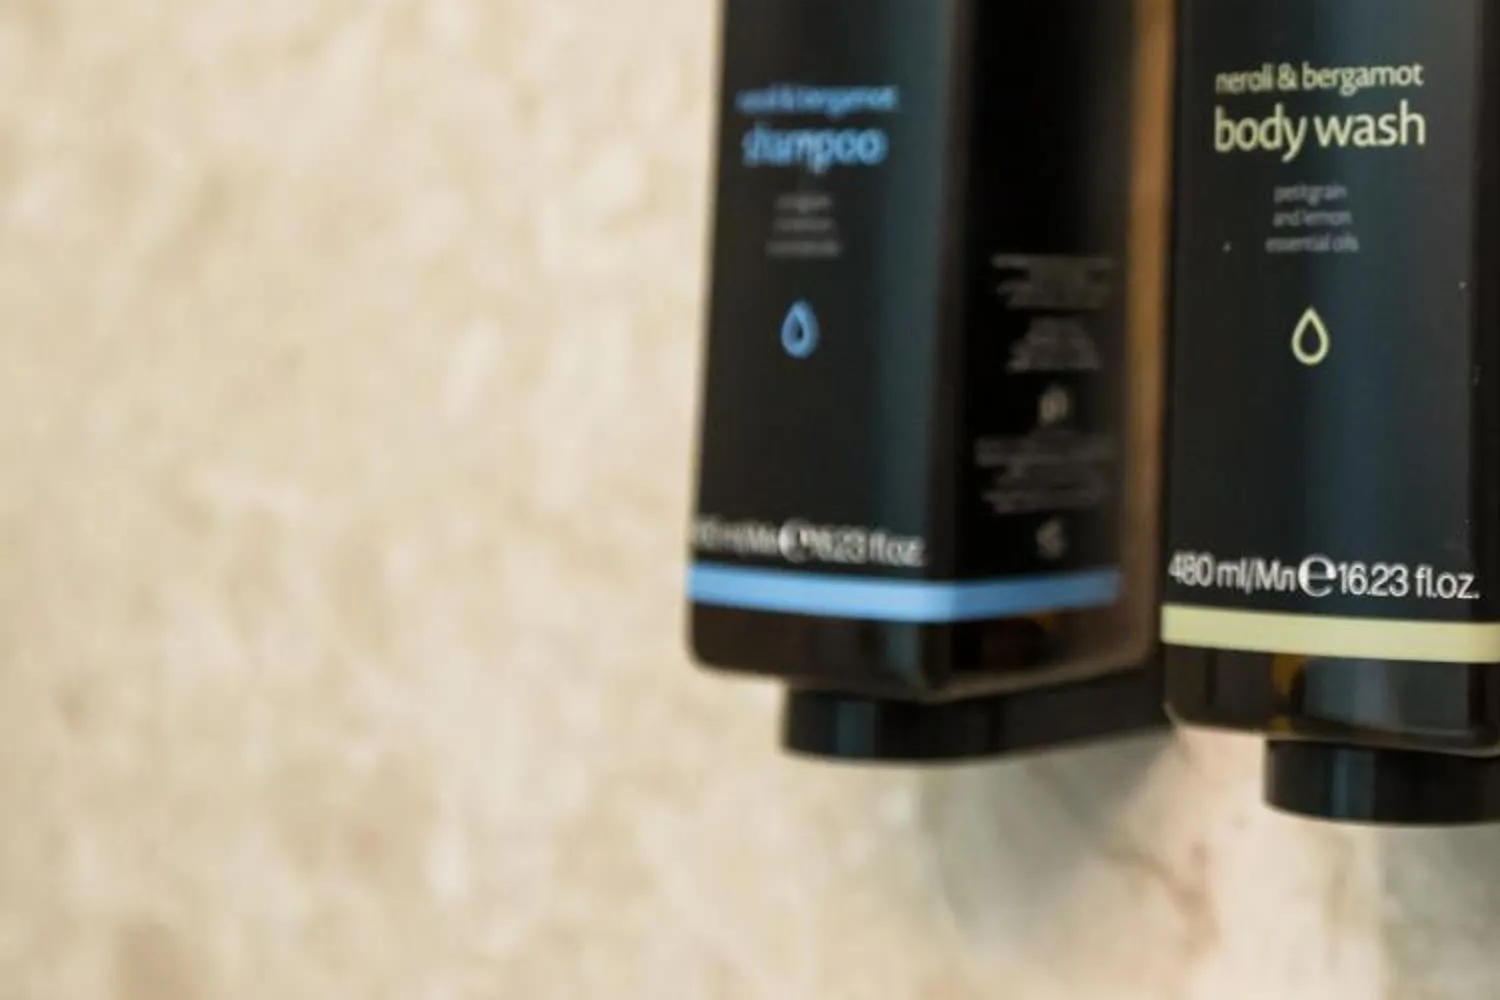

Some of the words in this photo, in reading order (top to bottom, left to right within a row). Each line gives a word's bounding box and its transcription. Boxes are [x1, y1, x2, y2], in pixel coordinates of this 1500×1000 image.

[1215, 62, 1274, 95] neroli
[1277, 63, 1298, 90] &
[1302, 61, 1425, 96] bergamot
[1214, 102, 1308, 163] body
[1313, 99, 1426, 148] wash
[1168, 550, 1214, 587] 480
[1338, 562, 1410, 597] 16.23
